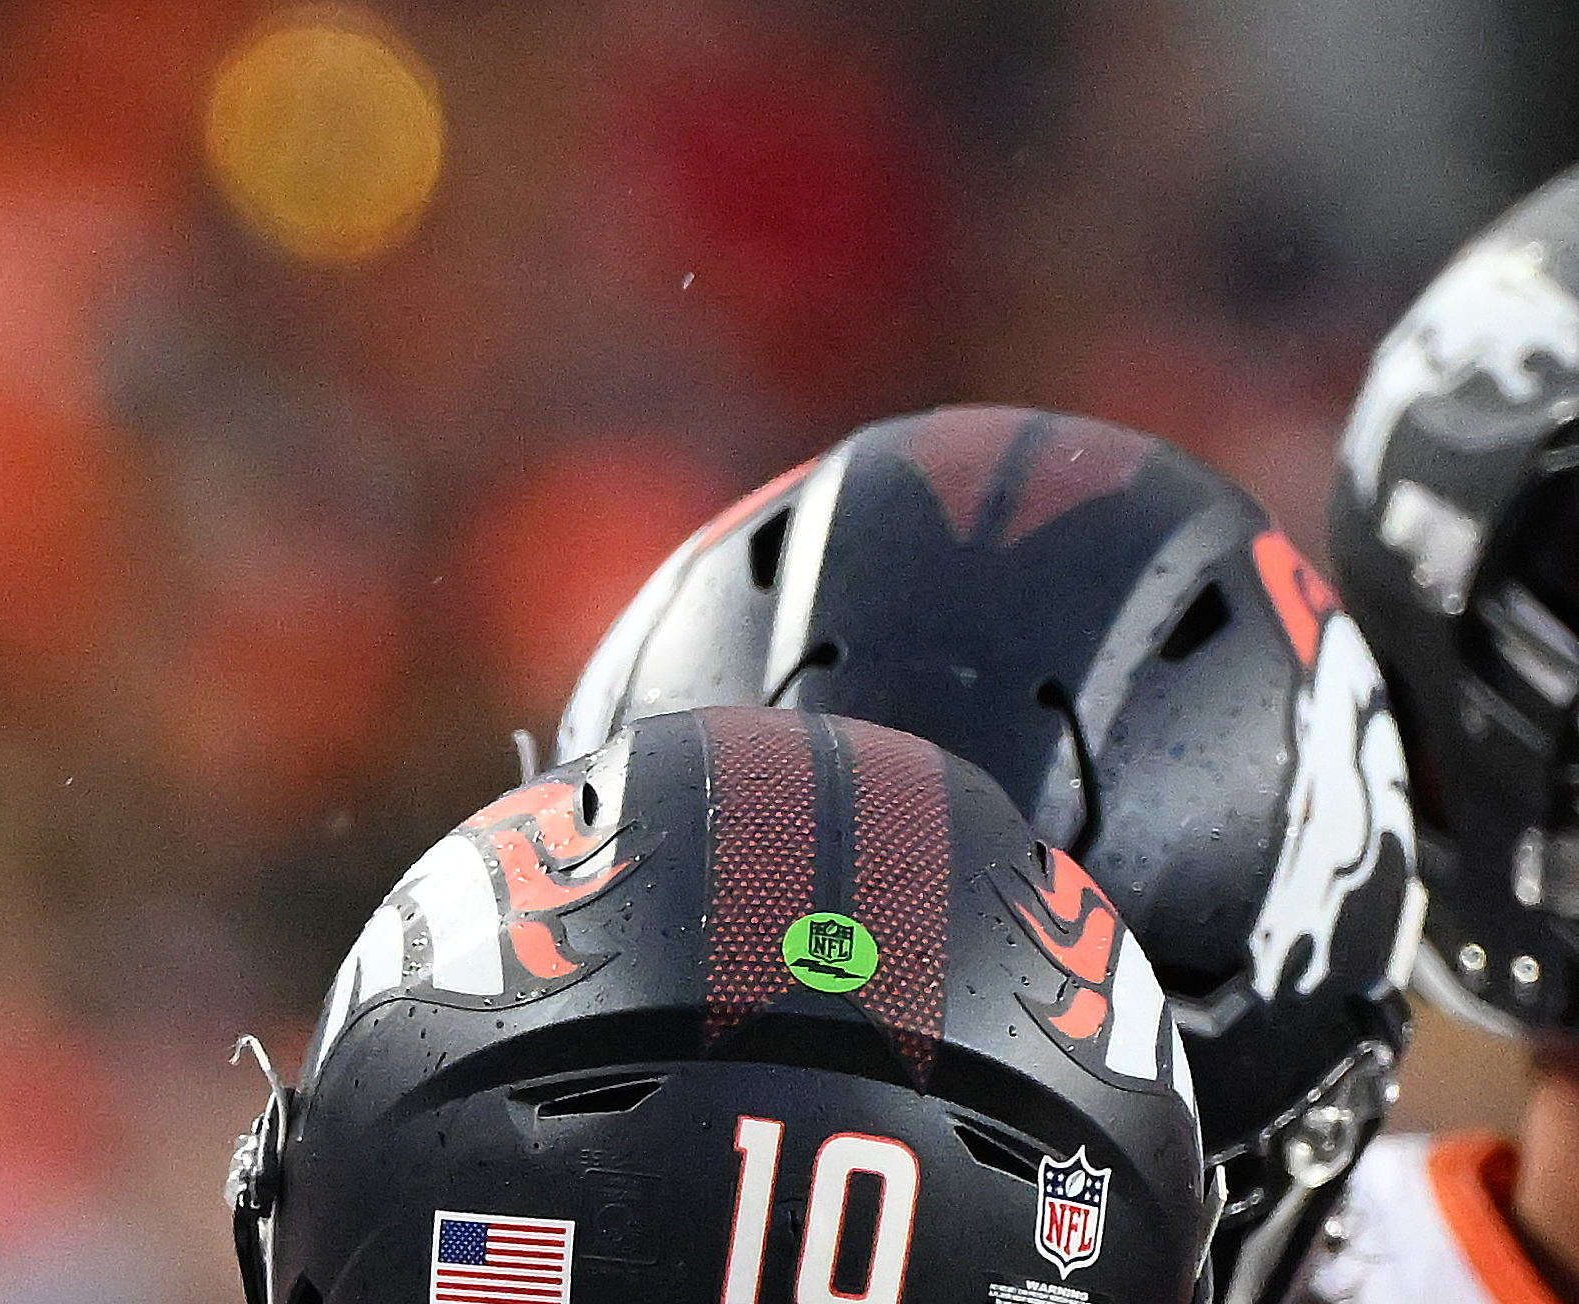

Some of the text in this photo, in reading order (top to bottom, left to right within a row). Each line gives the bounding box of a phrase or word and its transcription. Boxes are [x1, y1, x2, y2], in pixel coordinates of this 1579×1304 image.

[812, 936, 849, 959] NFL
[1046, 1201, 1093, 1256] NFL
[1025, 1280, 1089, 1302] WARNING
